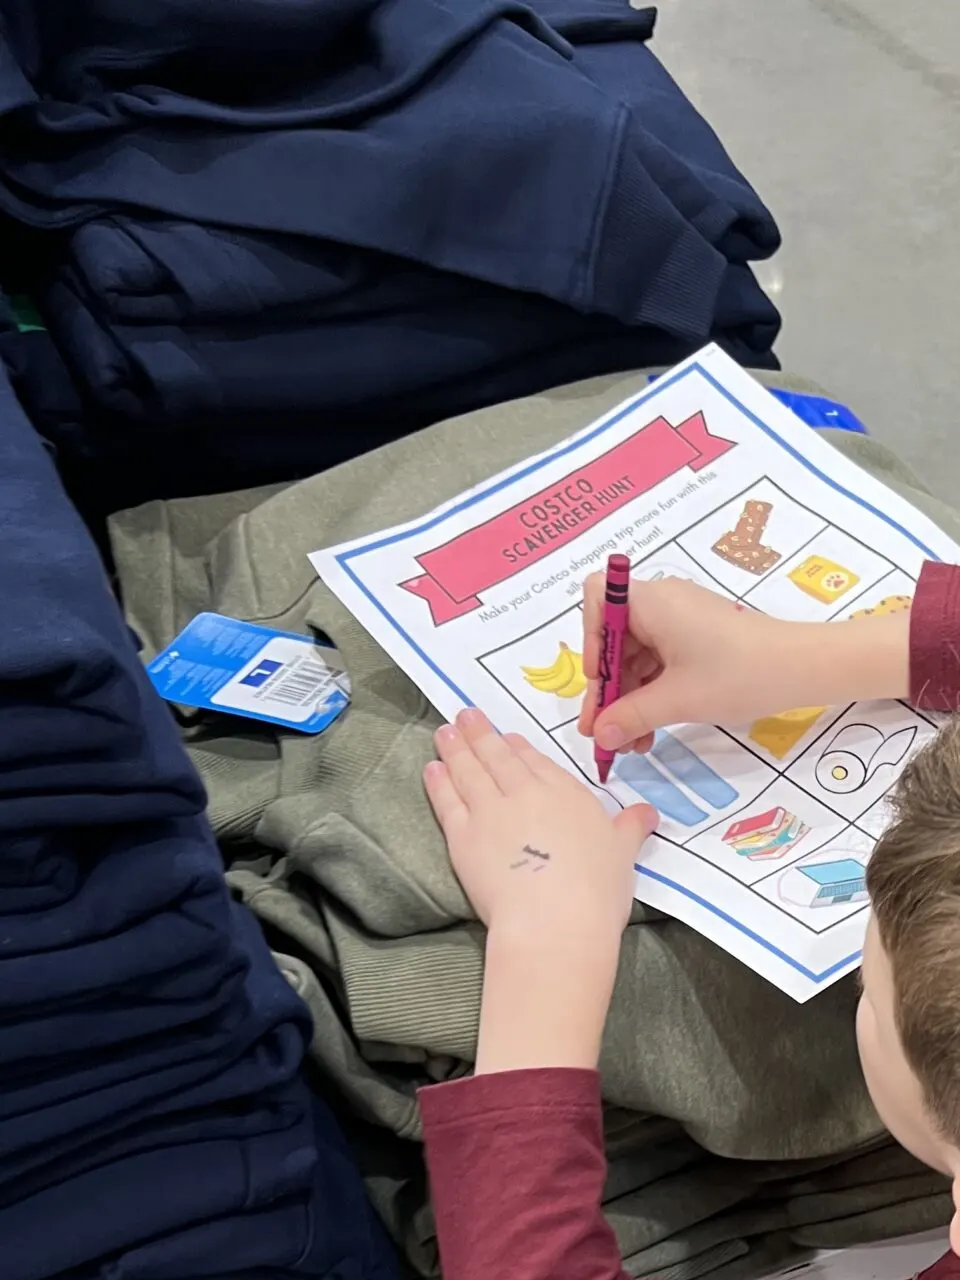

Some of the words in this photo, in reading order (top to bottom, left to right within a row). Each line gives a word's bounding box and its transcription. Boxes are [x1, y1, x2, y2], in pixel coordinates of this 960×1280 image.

[502, 500, 597, 563] SCAVENGER
[594, 475, 636, 506] HUNT
[520, 478, 594, 528] COSTCO
[633, 526, 664, 549] hunt!
[478, 604, 510, 623] Make
[508, 591, 533, 610] your
[530, 569, 570, 594] Costco
[569, 538, 618, 572] shopping
[614, 525, 634, 540] trip
[633, 509, 660, 528] more
[657, 498, 678, 512] fun
[676, 483, 700, 500] with
[697, 471, 718, 486] this
